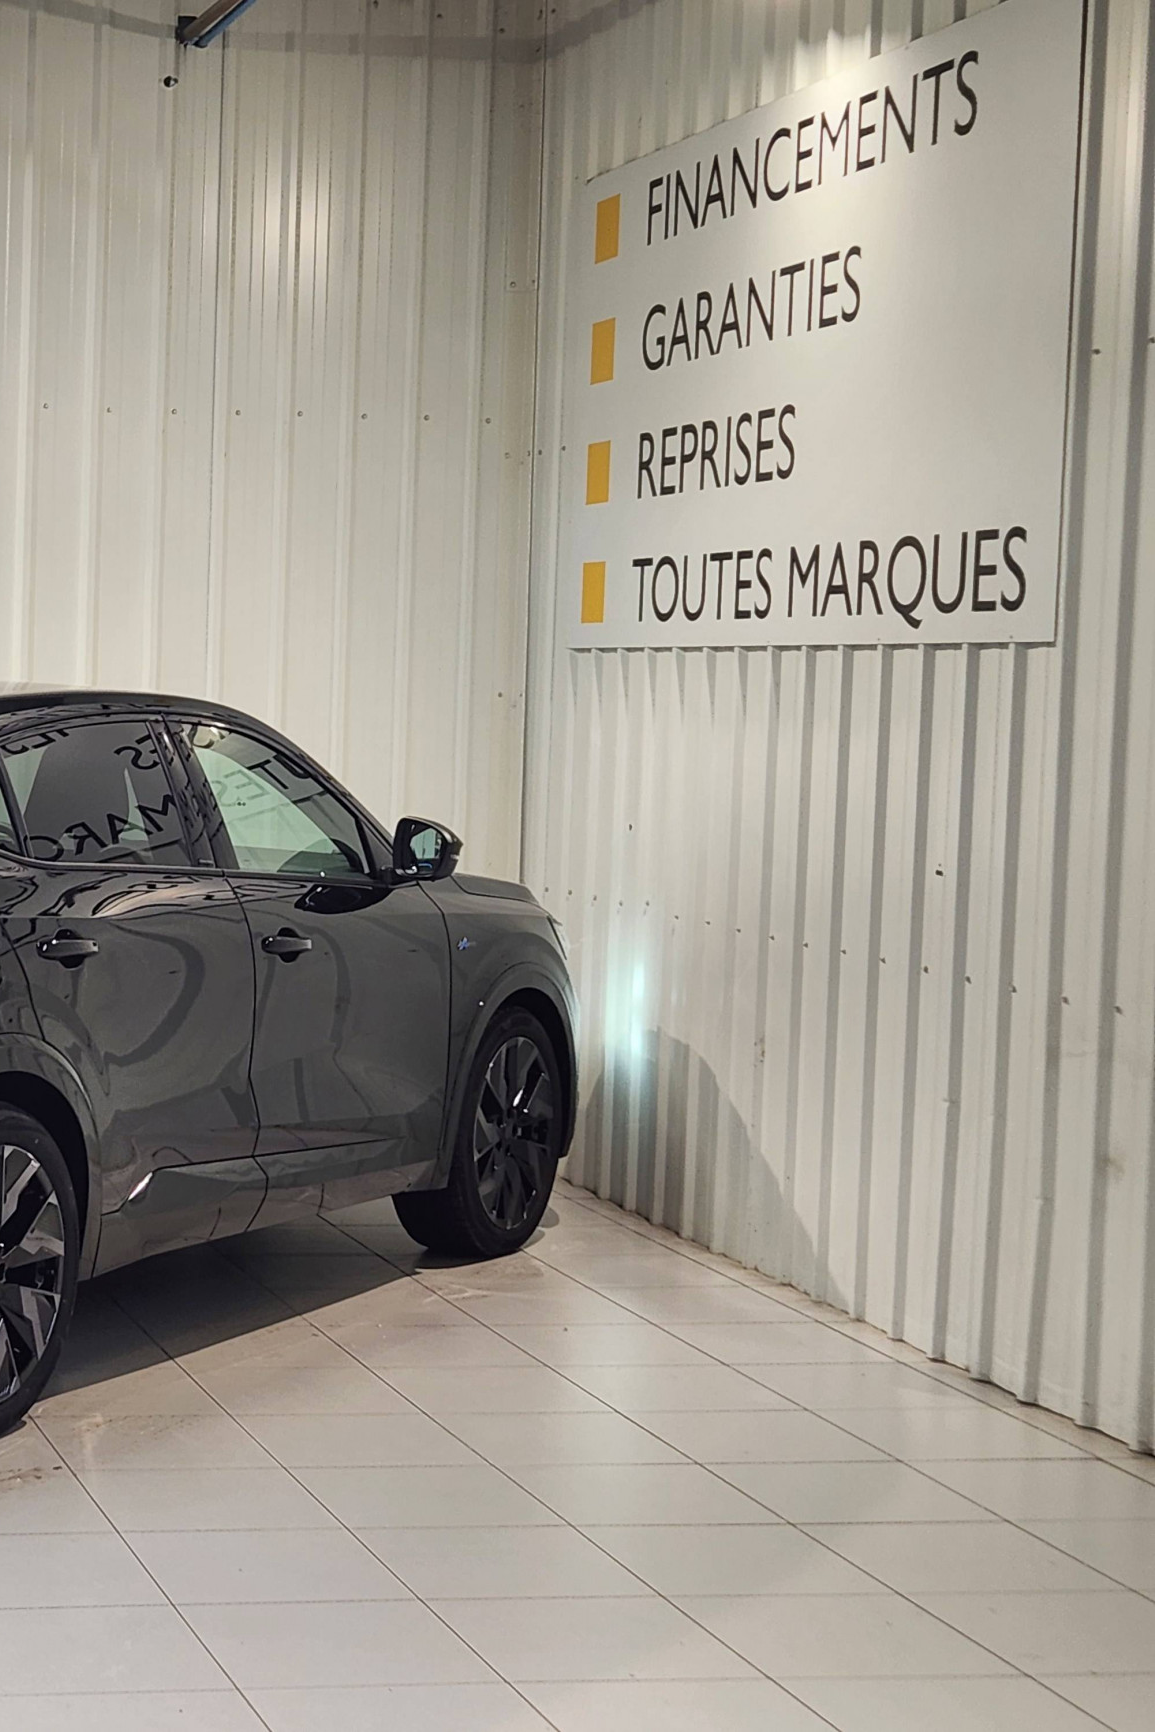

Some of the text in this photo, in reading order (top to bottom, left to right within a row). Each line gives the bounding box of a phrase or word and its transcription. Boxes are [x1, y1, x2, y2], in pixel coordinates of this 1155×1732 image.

[647, 50, 979, 245] FINANCEMENTS
[642, 246, 862, 370] GARANTIES
[637, 404, 796, 499] REPRISES
[632, 526, 1027, 629] TOUTES MARQUES
